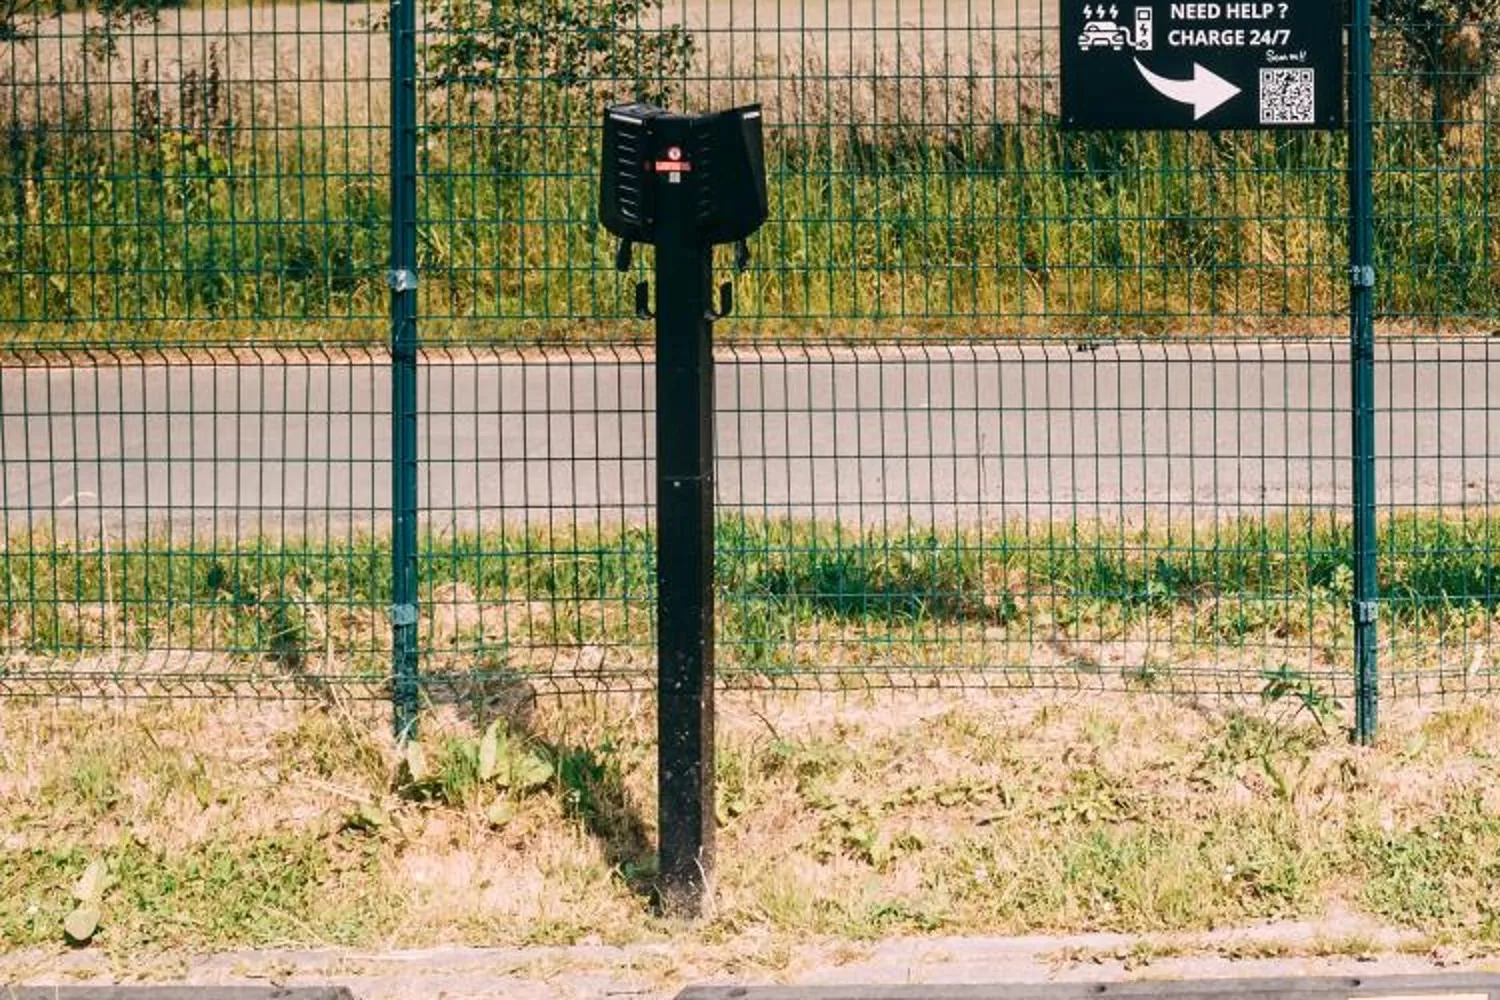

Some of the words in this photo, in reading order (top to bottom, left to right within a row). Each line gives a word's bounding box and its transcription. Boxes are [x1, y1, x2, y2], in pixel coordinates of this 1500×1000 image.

[1171, 3, 1220, 19] NEED
[1227, 3, 1274, 19] HELP
[1168, 30, 1244, 46] CHARGE
[1250, 30, 1290, 45] 24/7
